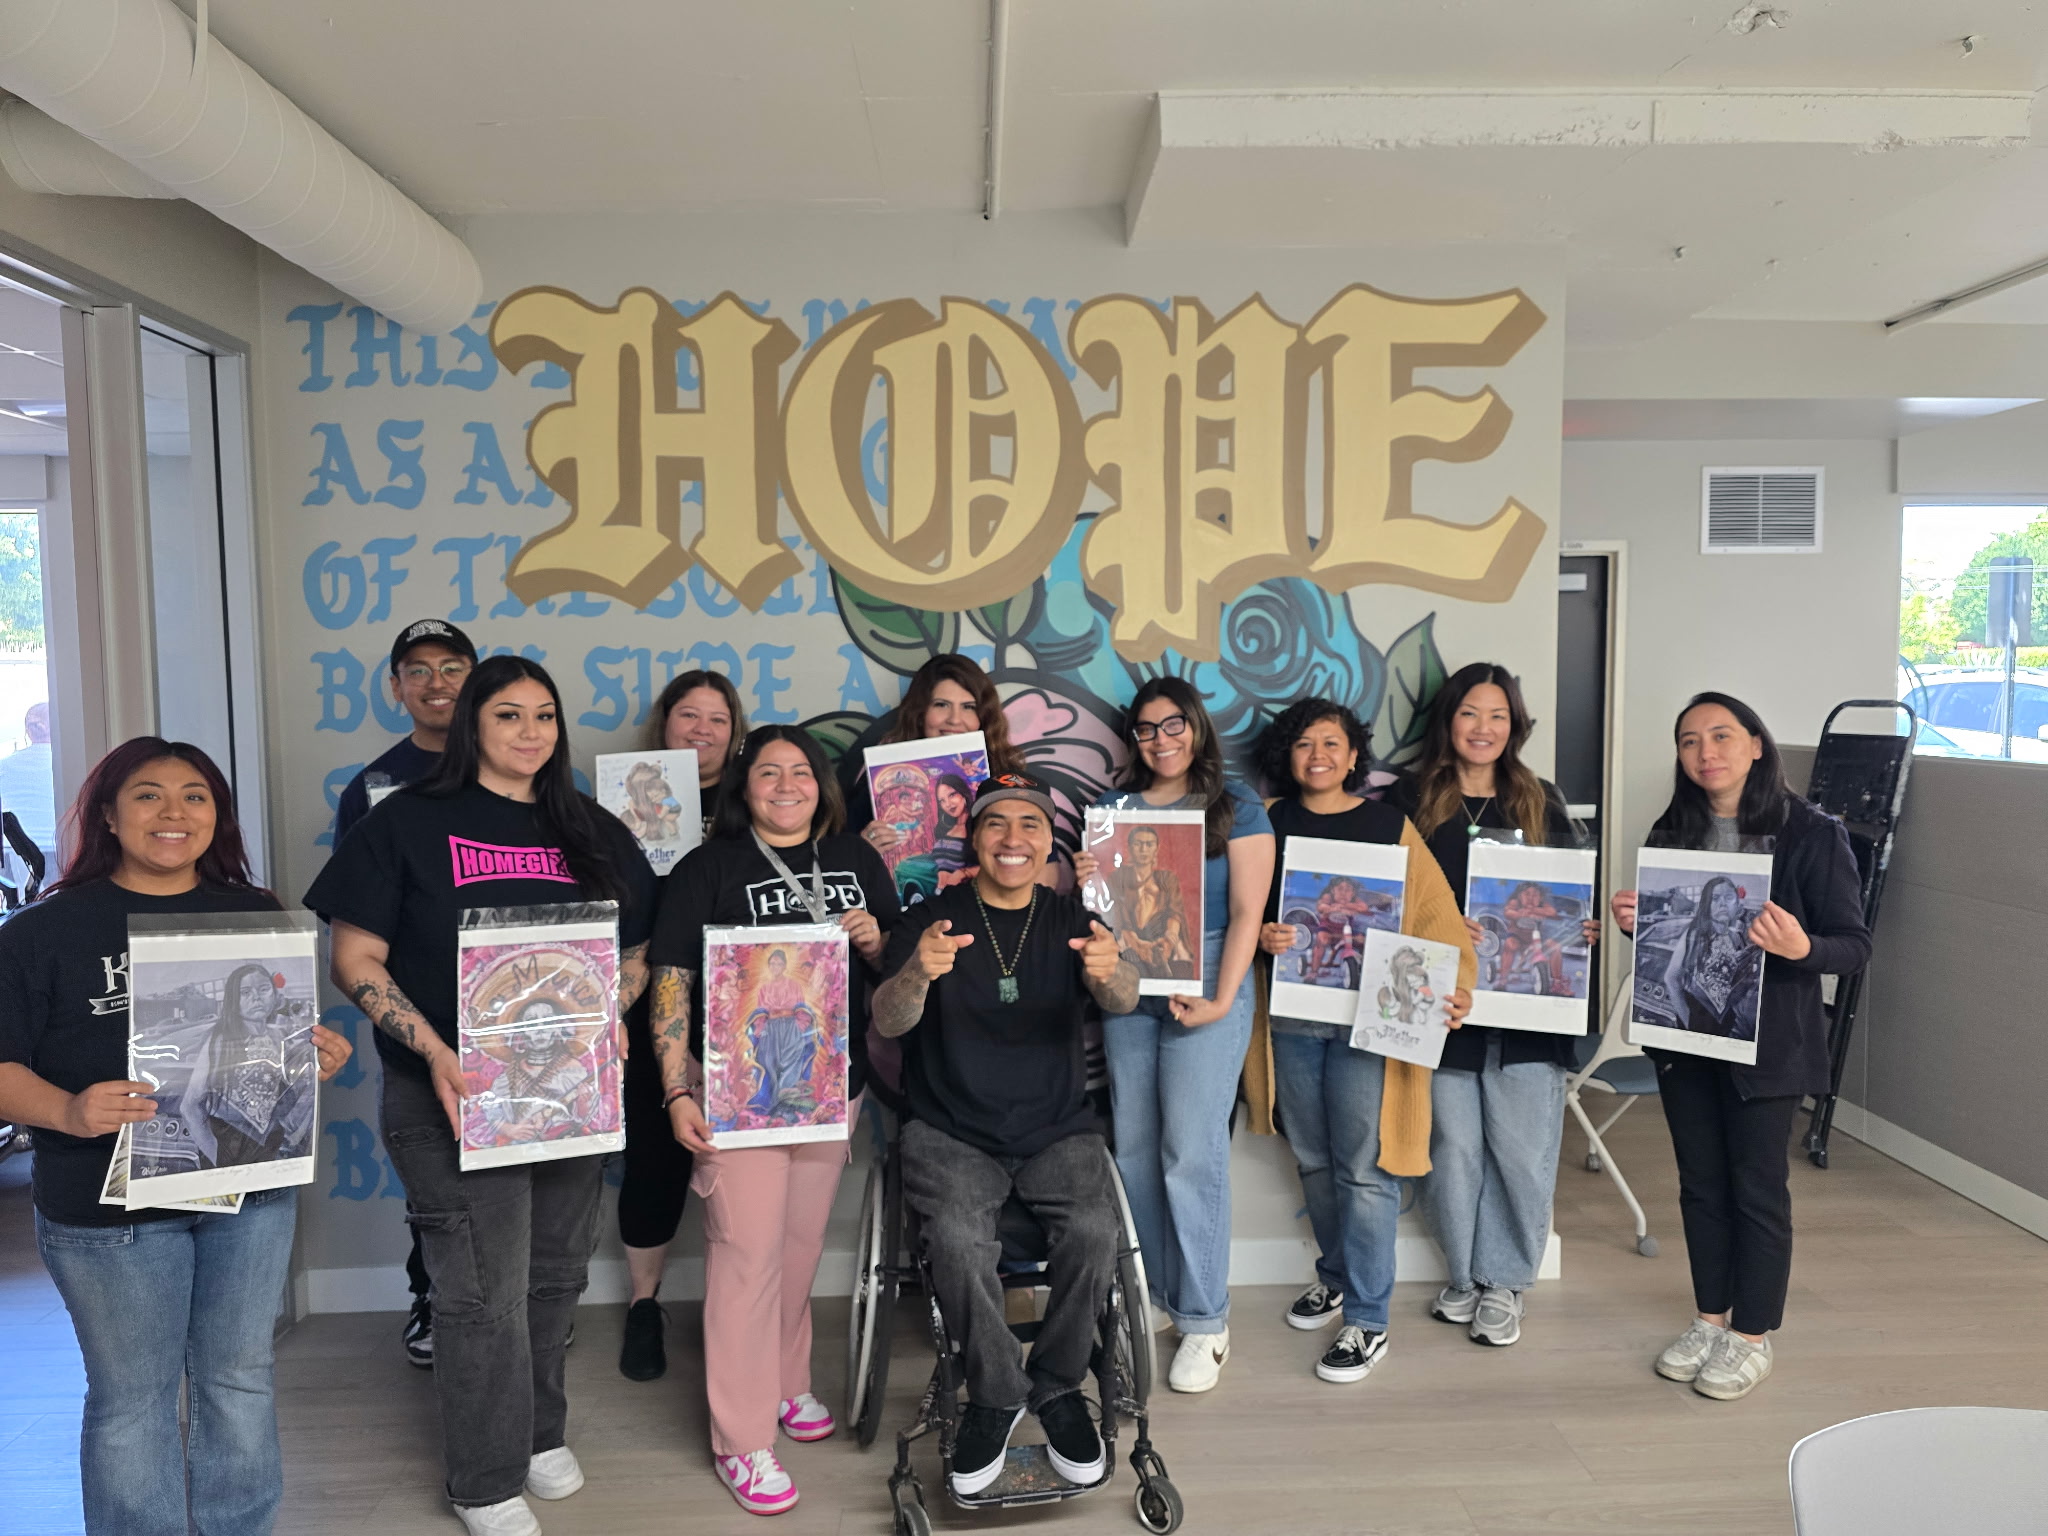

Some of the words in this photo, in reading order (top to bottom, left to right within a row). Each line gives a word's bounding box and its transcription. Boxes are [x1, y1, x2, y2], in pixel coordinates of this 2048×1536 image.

[302, 419, 427, 510] AS
[489, 282, 1547, 662] HOPE
[302, 534, 418, 631] OF
